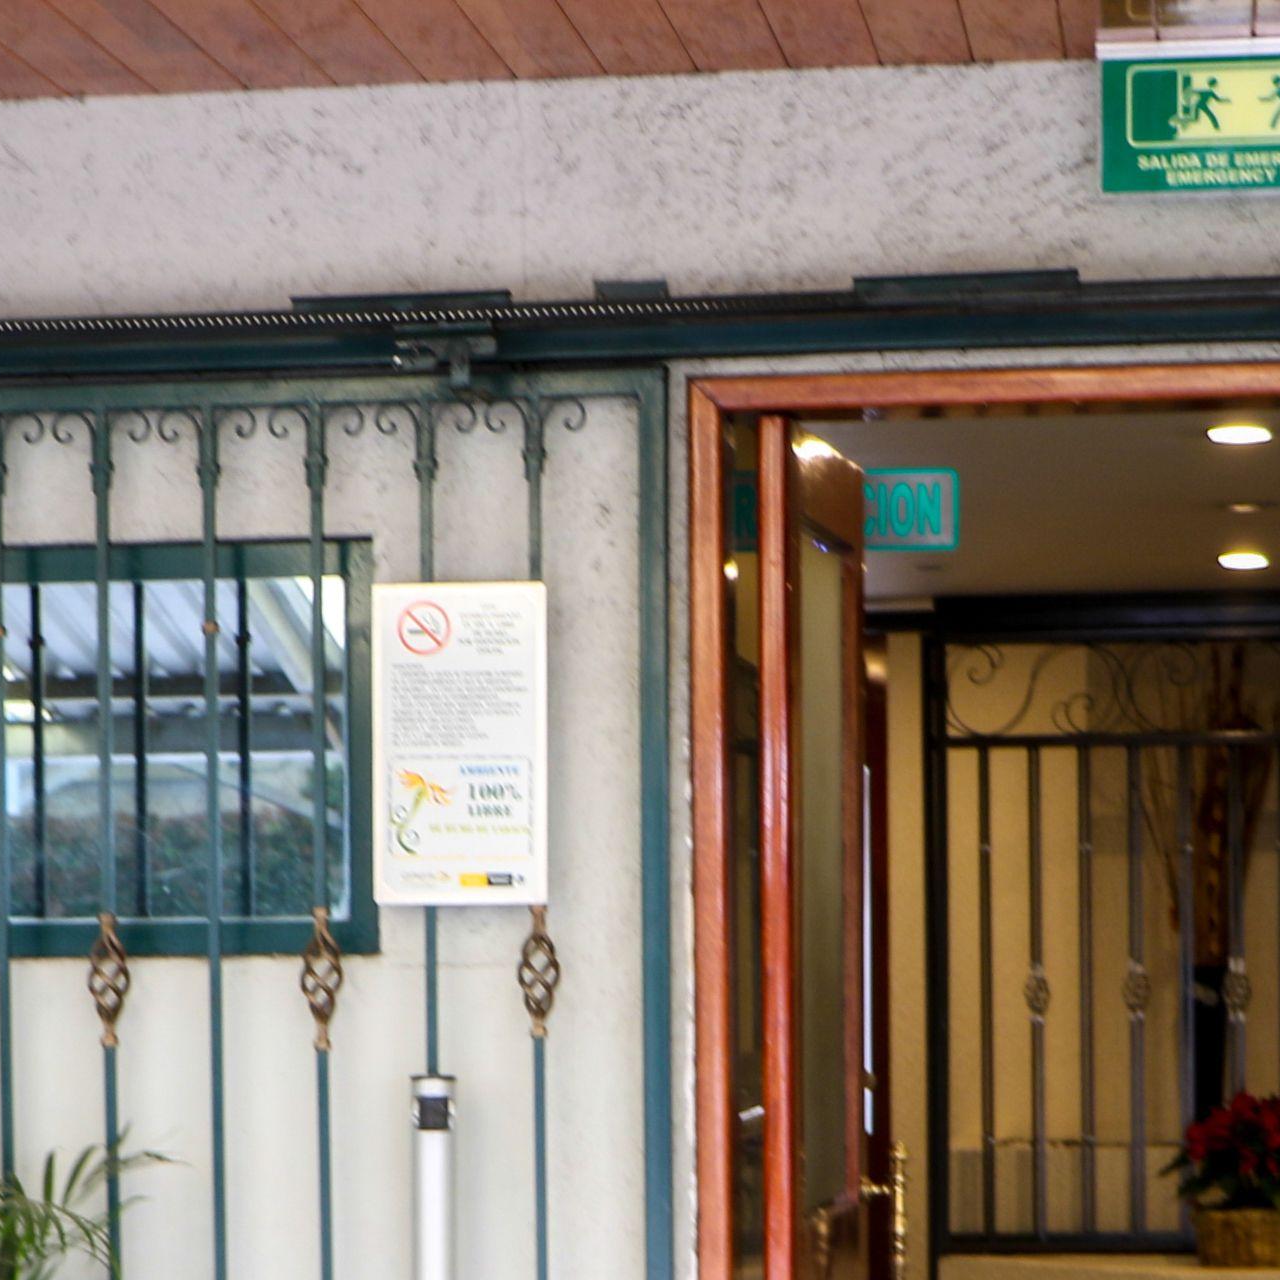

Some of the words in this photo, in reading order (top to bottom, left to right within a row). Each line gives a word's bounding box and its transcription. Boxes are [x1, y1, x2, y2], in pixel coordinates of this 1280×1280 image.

[1137, 152, 1202, 170] SALIDA
[1205, 152, 1229, 167] DE
[1165, 167, 1276, 185] EMERGENCY
[467, 783, 523, 801] 100%
